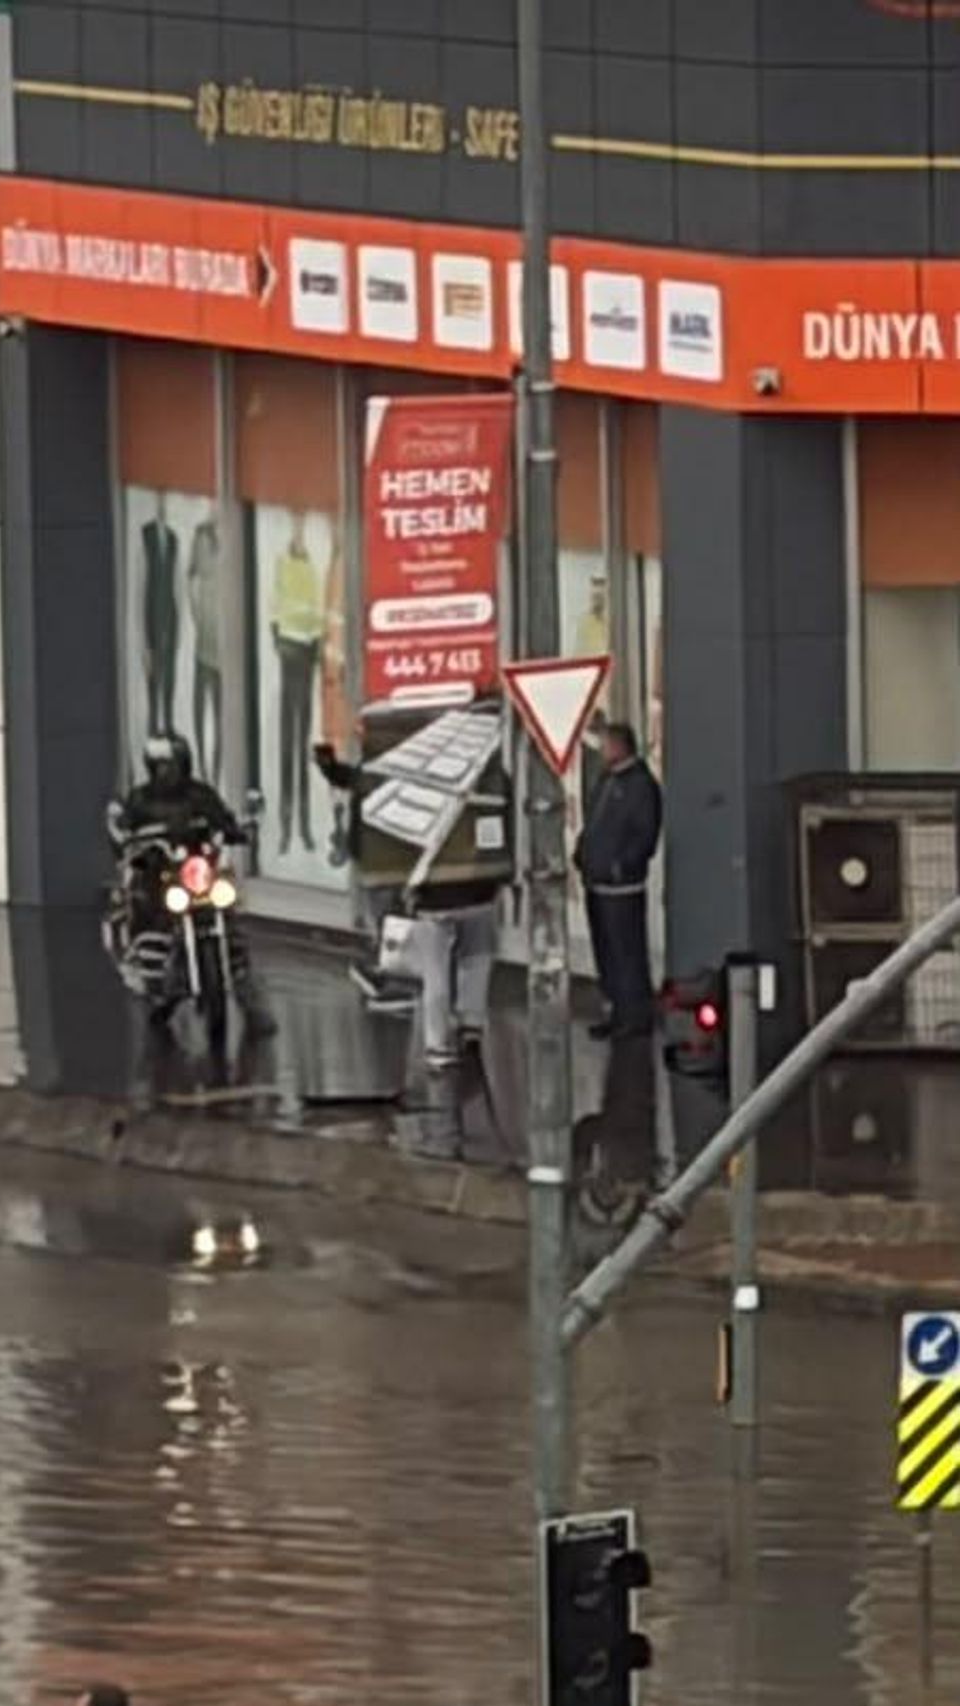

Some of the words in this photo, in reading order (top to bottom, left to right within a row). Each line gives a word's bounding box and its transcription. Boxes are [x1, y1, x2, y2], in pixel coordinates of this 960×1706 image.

[804, 301, 944, 360] DÜNYA
[380, 467, 490, 501] HEMEN
[381, 500, 486, 539] TESLİM
